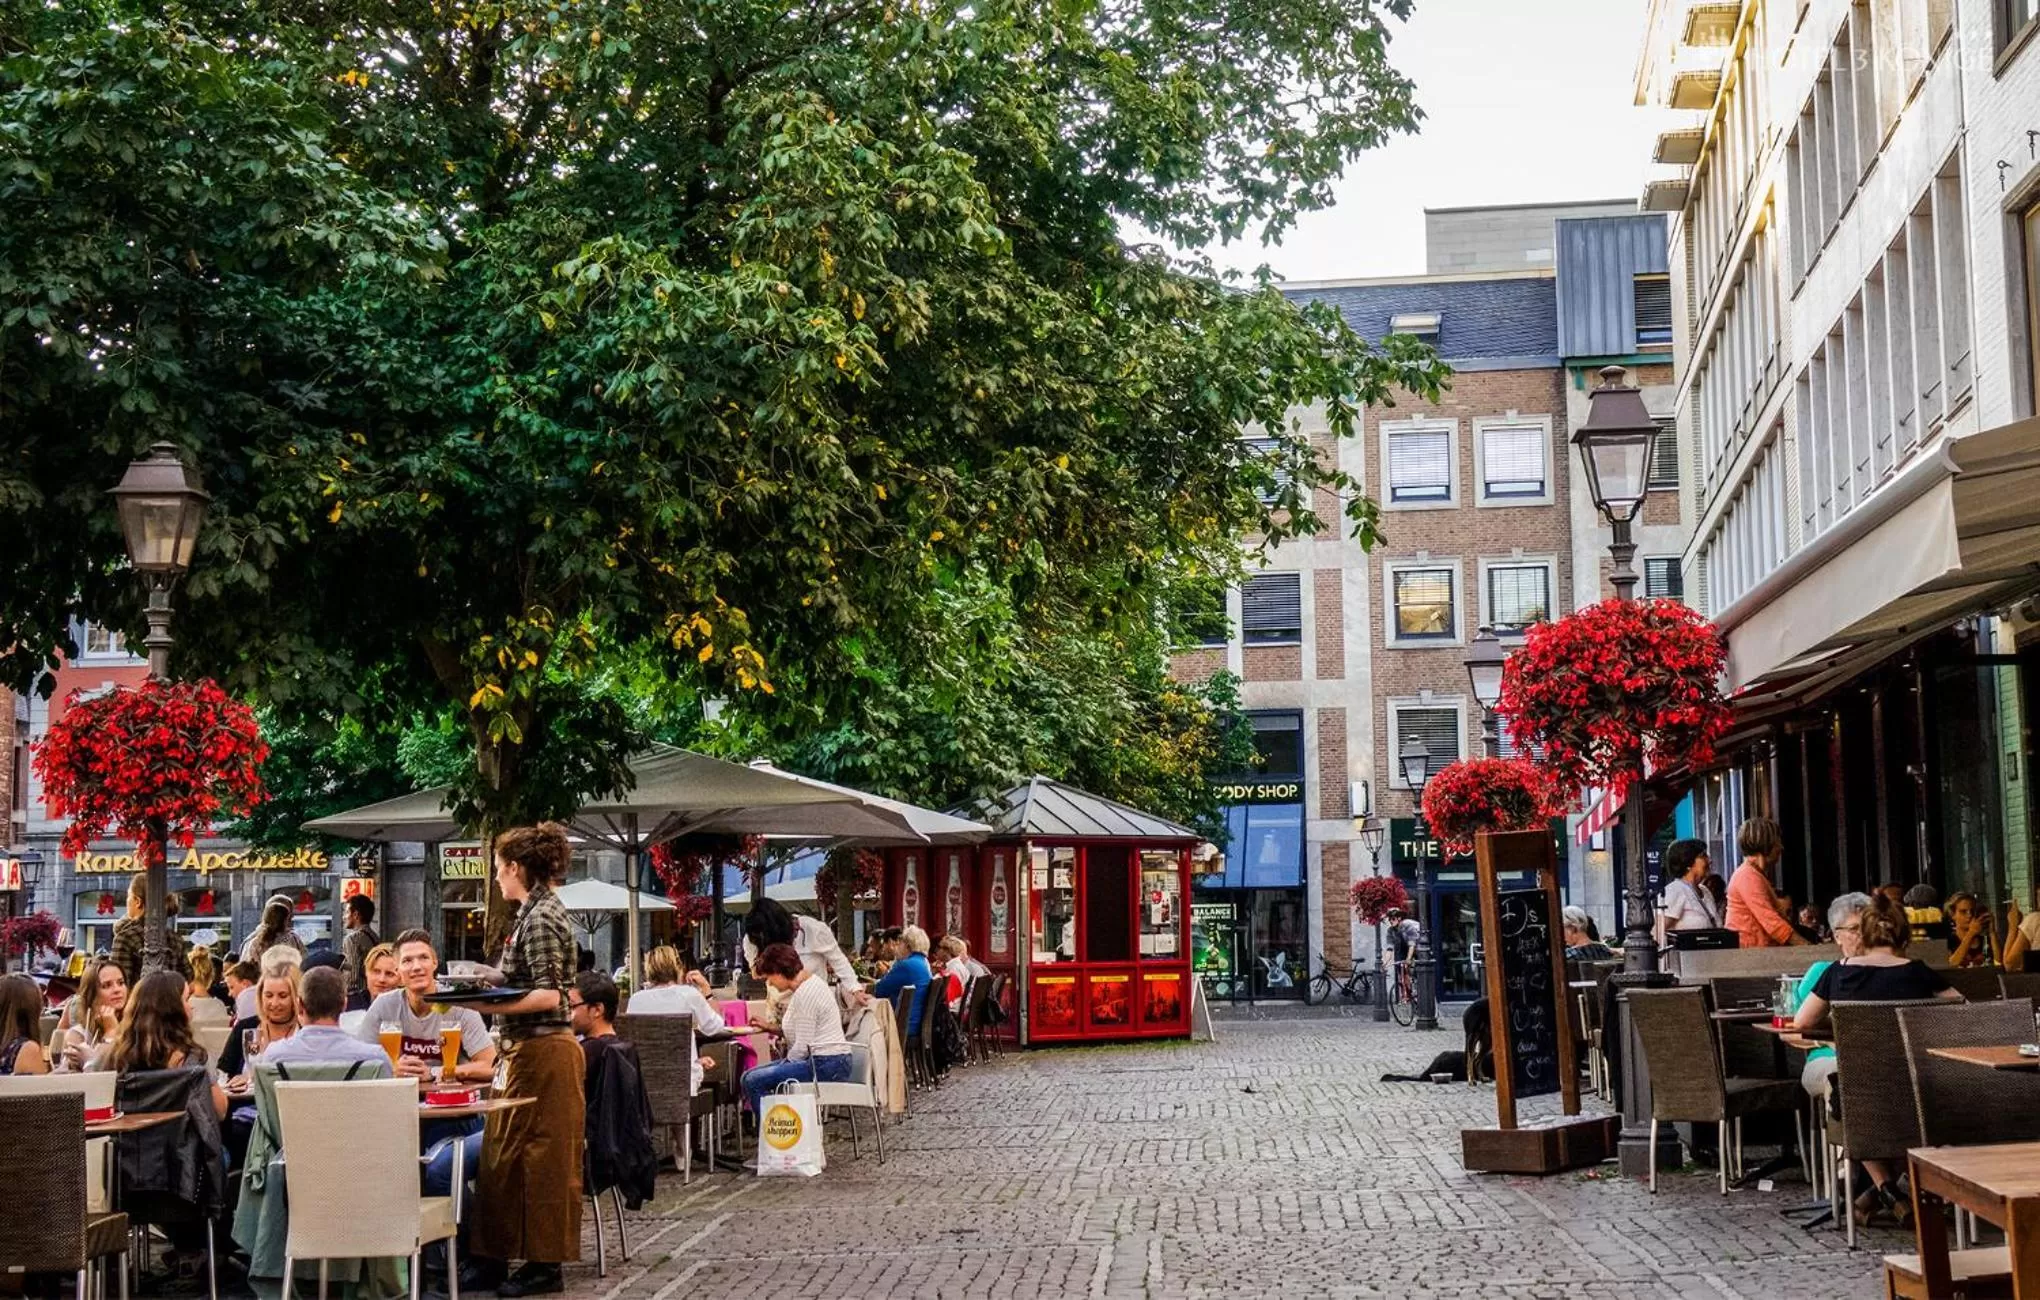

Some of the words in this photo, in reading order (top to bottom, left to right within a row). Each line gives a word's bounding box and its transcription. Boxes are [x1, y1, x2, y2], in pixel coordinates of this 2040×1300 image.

[1257, 784, 1297, 799] SHOP
[1399, 841, 1438, 858] THE
[1193, 908, 1232, 916] BALANCE
